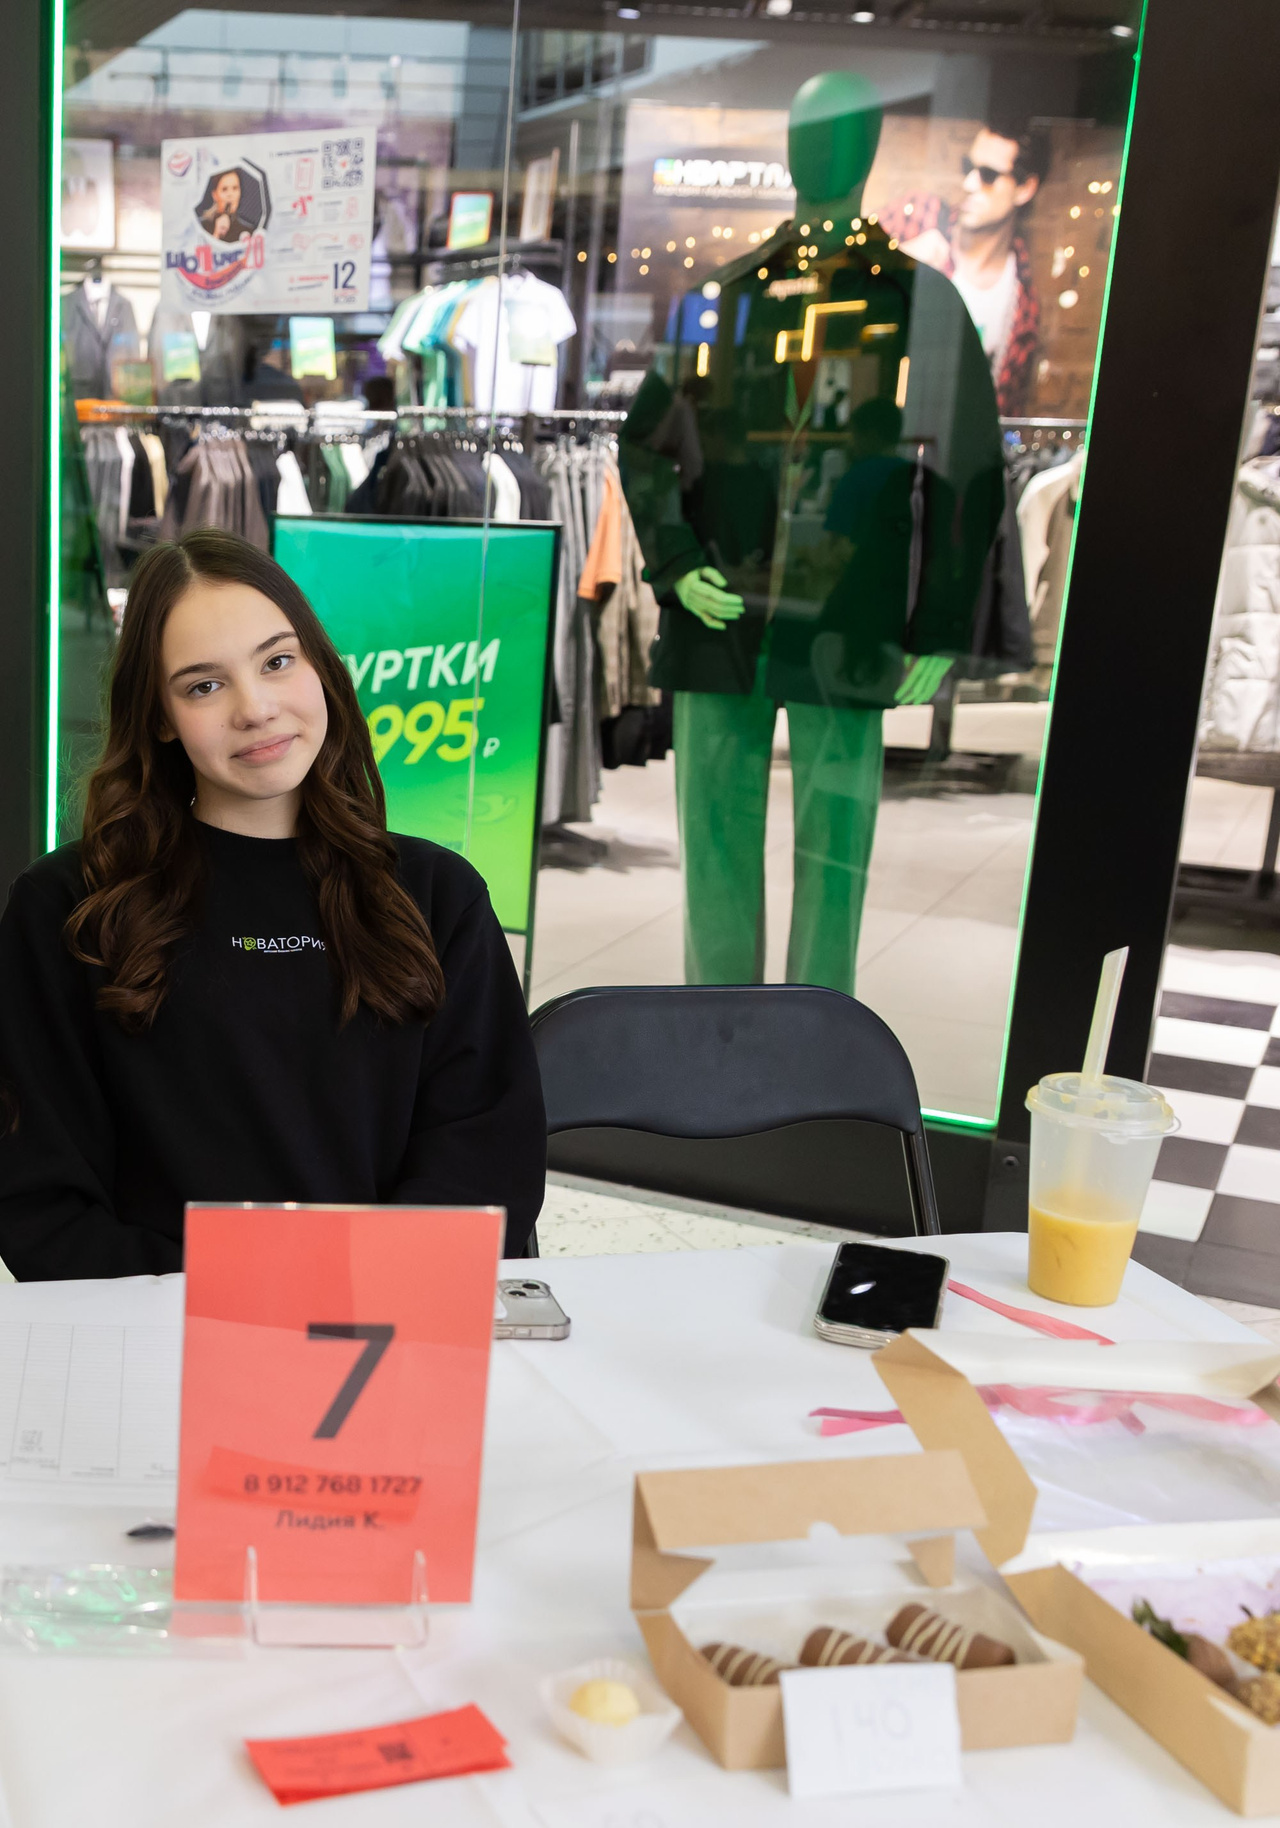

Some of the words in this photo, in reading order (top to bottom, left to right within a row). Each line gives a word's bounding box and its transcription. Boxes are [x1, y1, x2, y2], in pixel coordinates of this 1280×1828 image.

[333, 260, 356, 290] 12
[342, 638, 501, 694] УРТКИ
[307, 1322, 396, 1440] 7
[243, 1474, 260, 1494] 8
[267, 1474, 309, 1494] 912
[316, 1475, 362, 1494] 768
[369, 1475, 422, 1495] 1727
[275, 1509, 356, 1531] Лидия
[829, 1697, 914, 1746] 140
